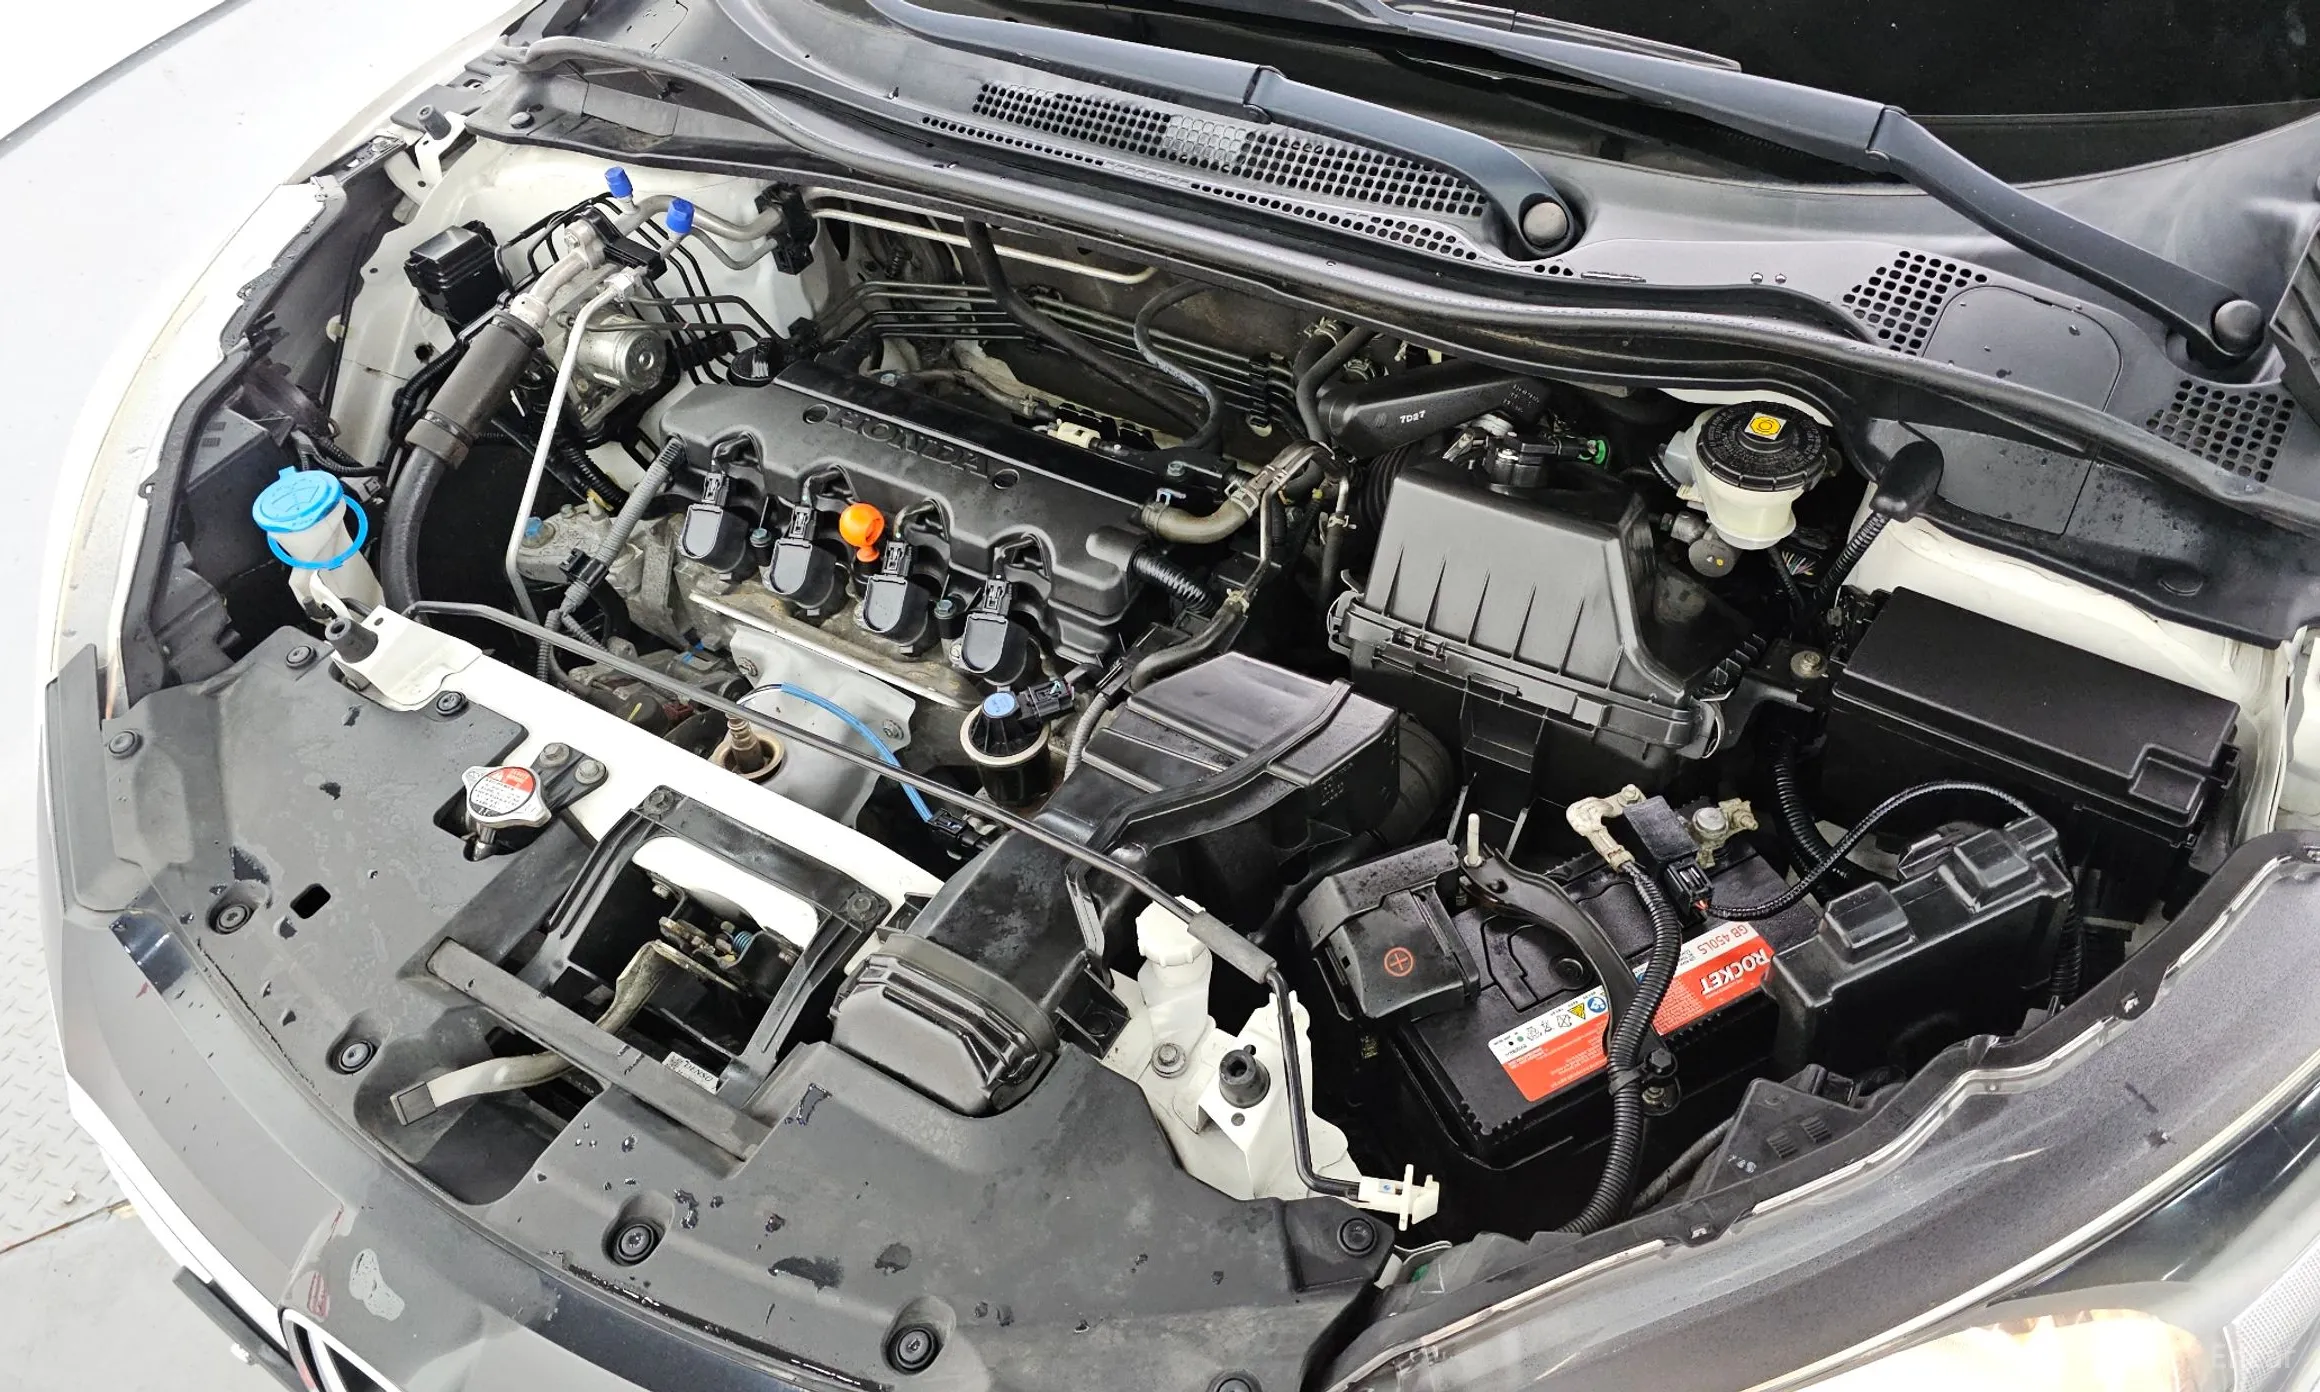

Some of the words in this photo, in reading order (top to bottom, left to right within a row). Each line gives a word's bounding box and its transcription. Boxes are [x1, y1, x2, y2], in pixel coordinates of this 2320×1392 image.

[825, 407, 990, 479] HONDA
[1697, 933, 1731, 955] 450LS
[1730, 924, 1749, 938] GB
[1701, 947, 1771, 996] ROCKET
